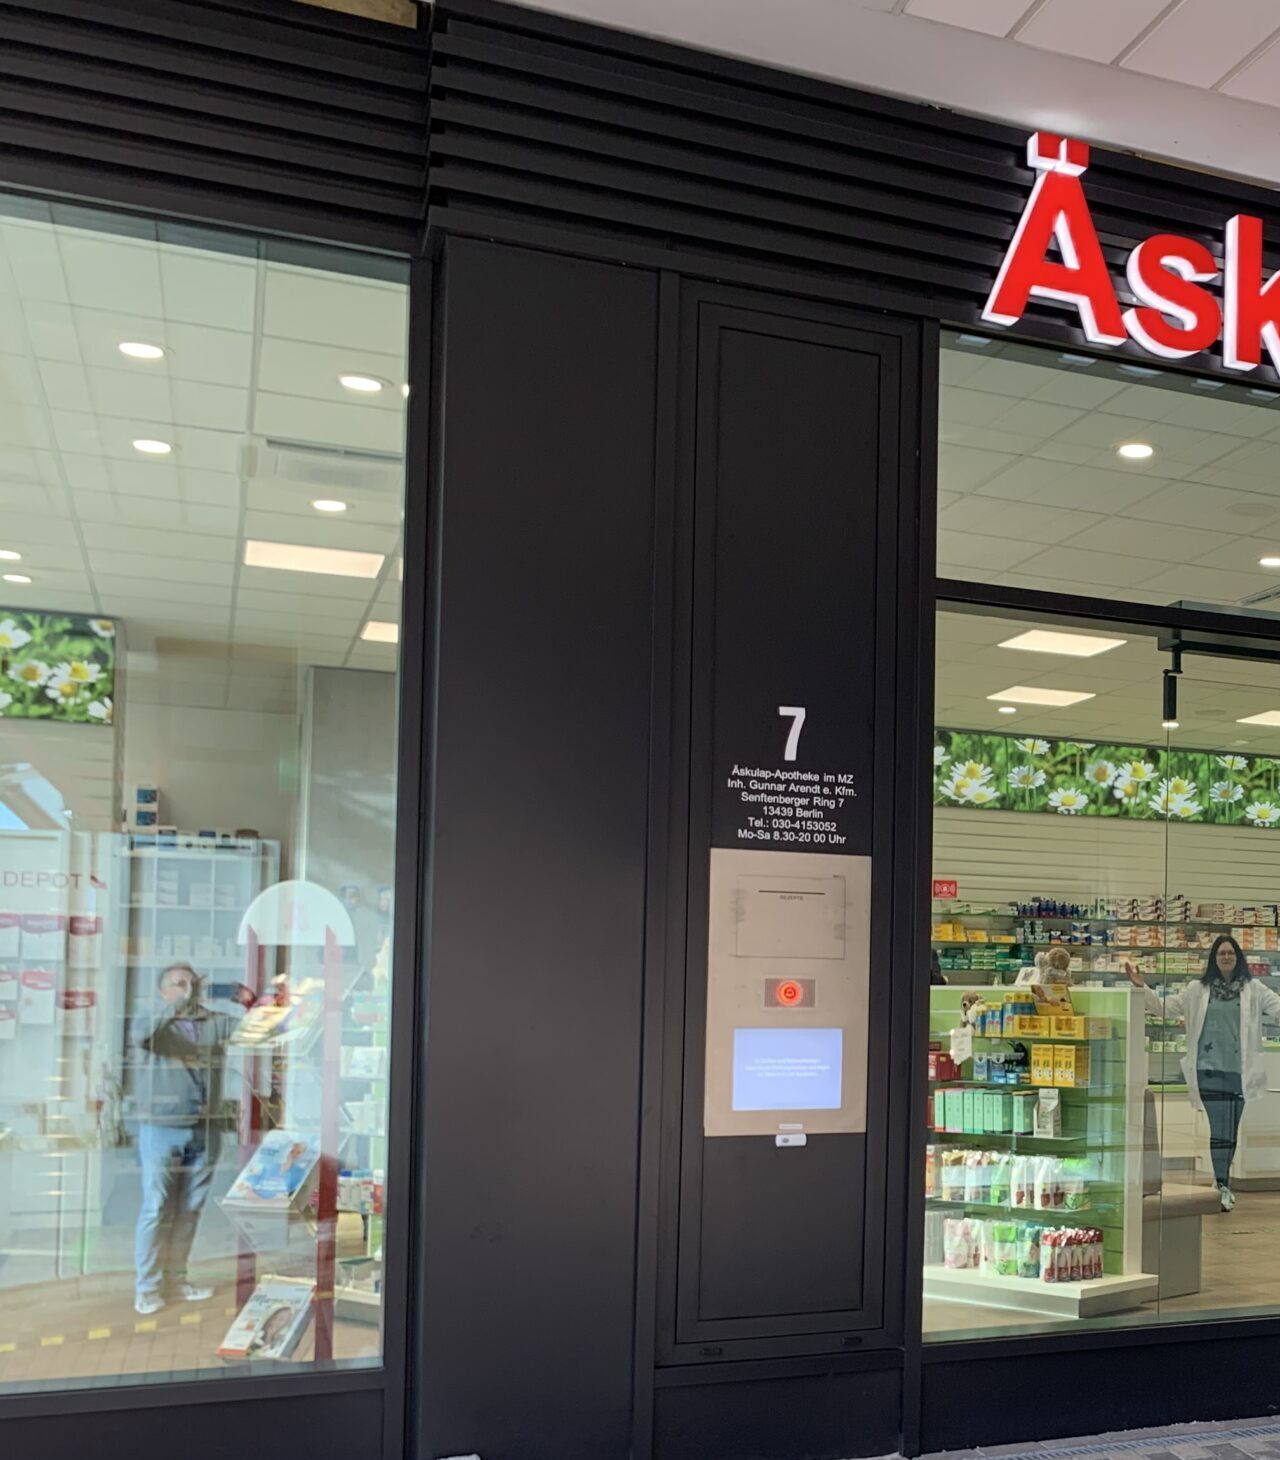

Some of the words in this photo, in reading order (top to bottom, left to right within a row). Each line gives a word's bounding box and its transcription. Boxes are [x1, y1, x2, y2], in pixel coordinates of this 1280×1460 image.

[778, 705, 806, 761] 7
[731, 764, 820, 781] Äskulap-Apotheke
[823, 772, 836, 783] im
[837, 773, 854, 784] MZ
[727, 778, 747, 789] Inh.
[749, 779, 787, 792] Gunnar
[788, 782, 821, 794] Arendt
[822, 786, 832, 795] e.
[834, 786, 858, 797] Kfm.
[741, 791, 811, 807] Senftenberger
[813, 796, 836, 809] Ring
[838, 798, 845, 808] 7
[763, 805, 794, 817] 13439
[795, 807, 824, 819] Berlin
[748, 816, 769, 828] Tel.:
[771, 818, 837, 832] 030-4153052
[737, 828, 771, 840] Mo-Sa
[828, 833, 847, 845] Uhr
[0, 870, 83, 890] DEPOT
